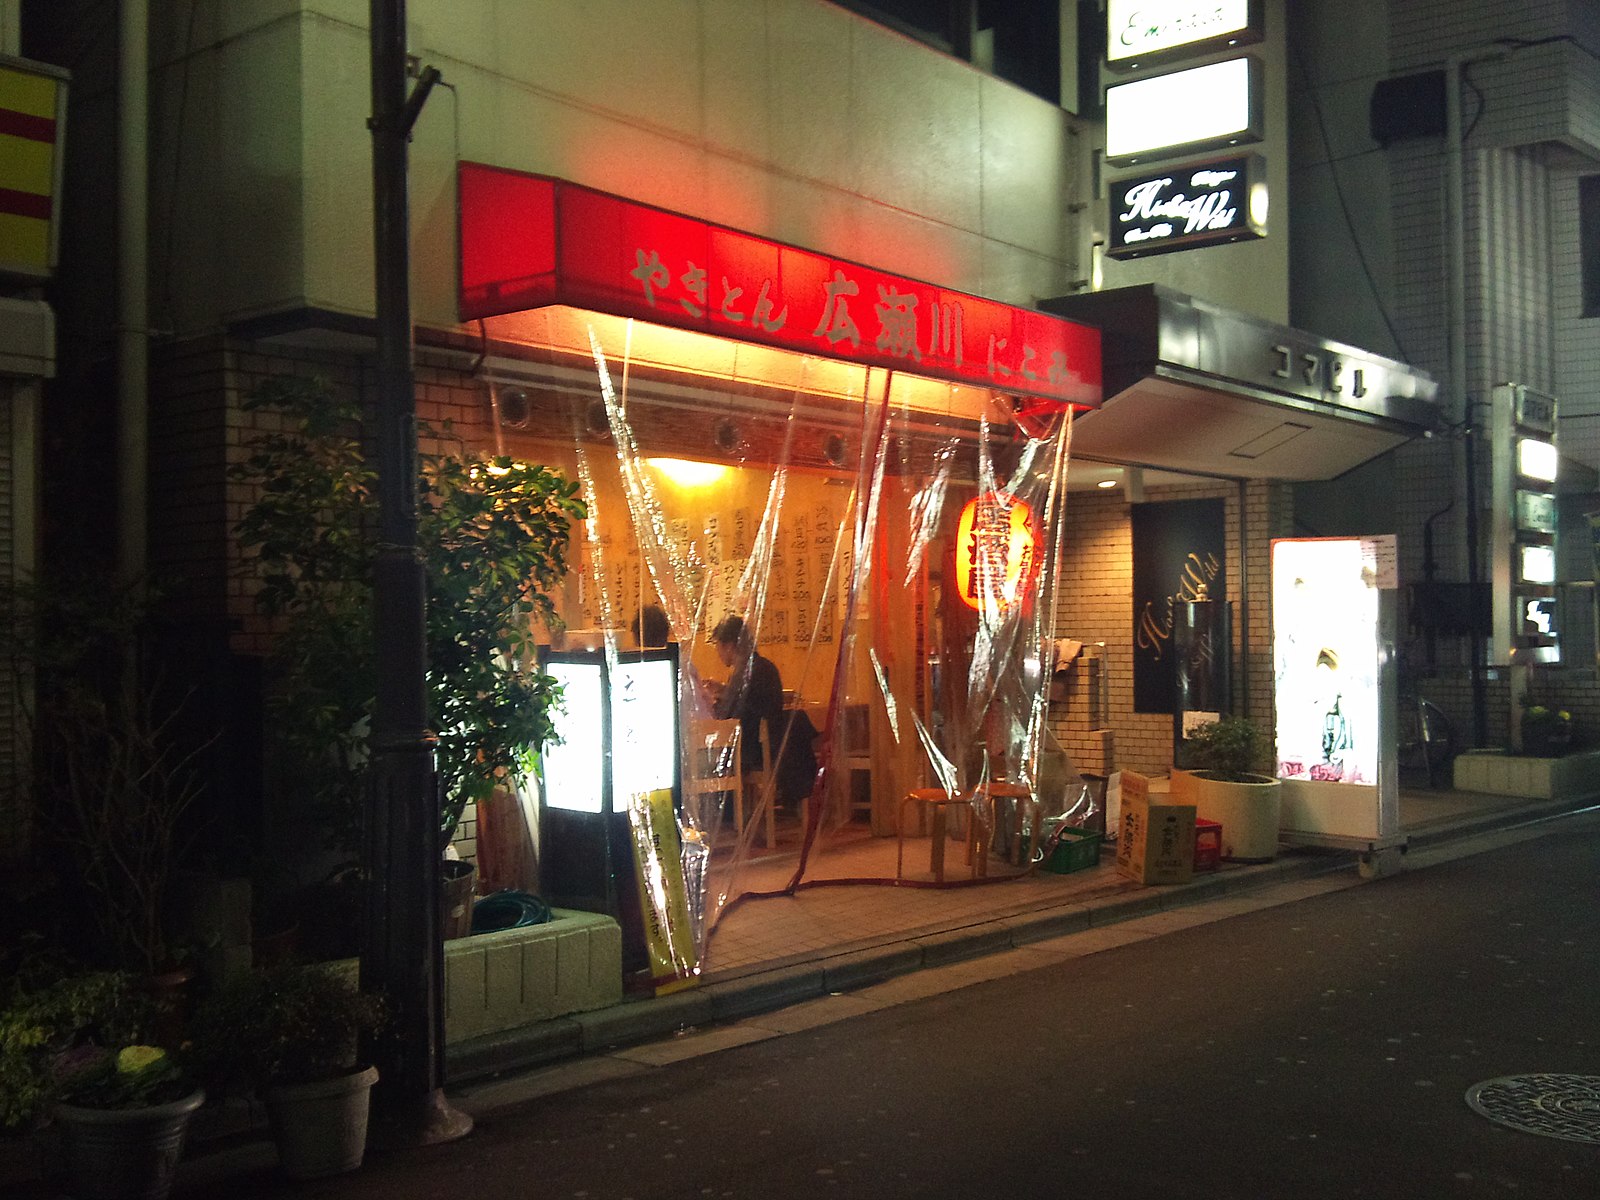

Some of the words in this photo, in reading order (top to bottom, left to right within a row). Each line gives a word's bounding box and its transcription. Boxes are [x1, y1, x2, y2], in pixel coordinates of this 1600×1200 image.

[631, 248, 788, 332] やきとん
[813, 269, 964, 366] 広瀬川
